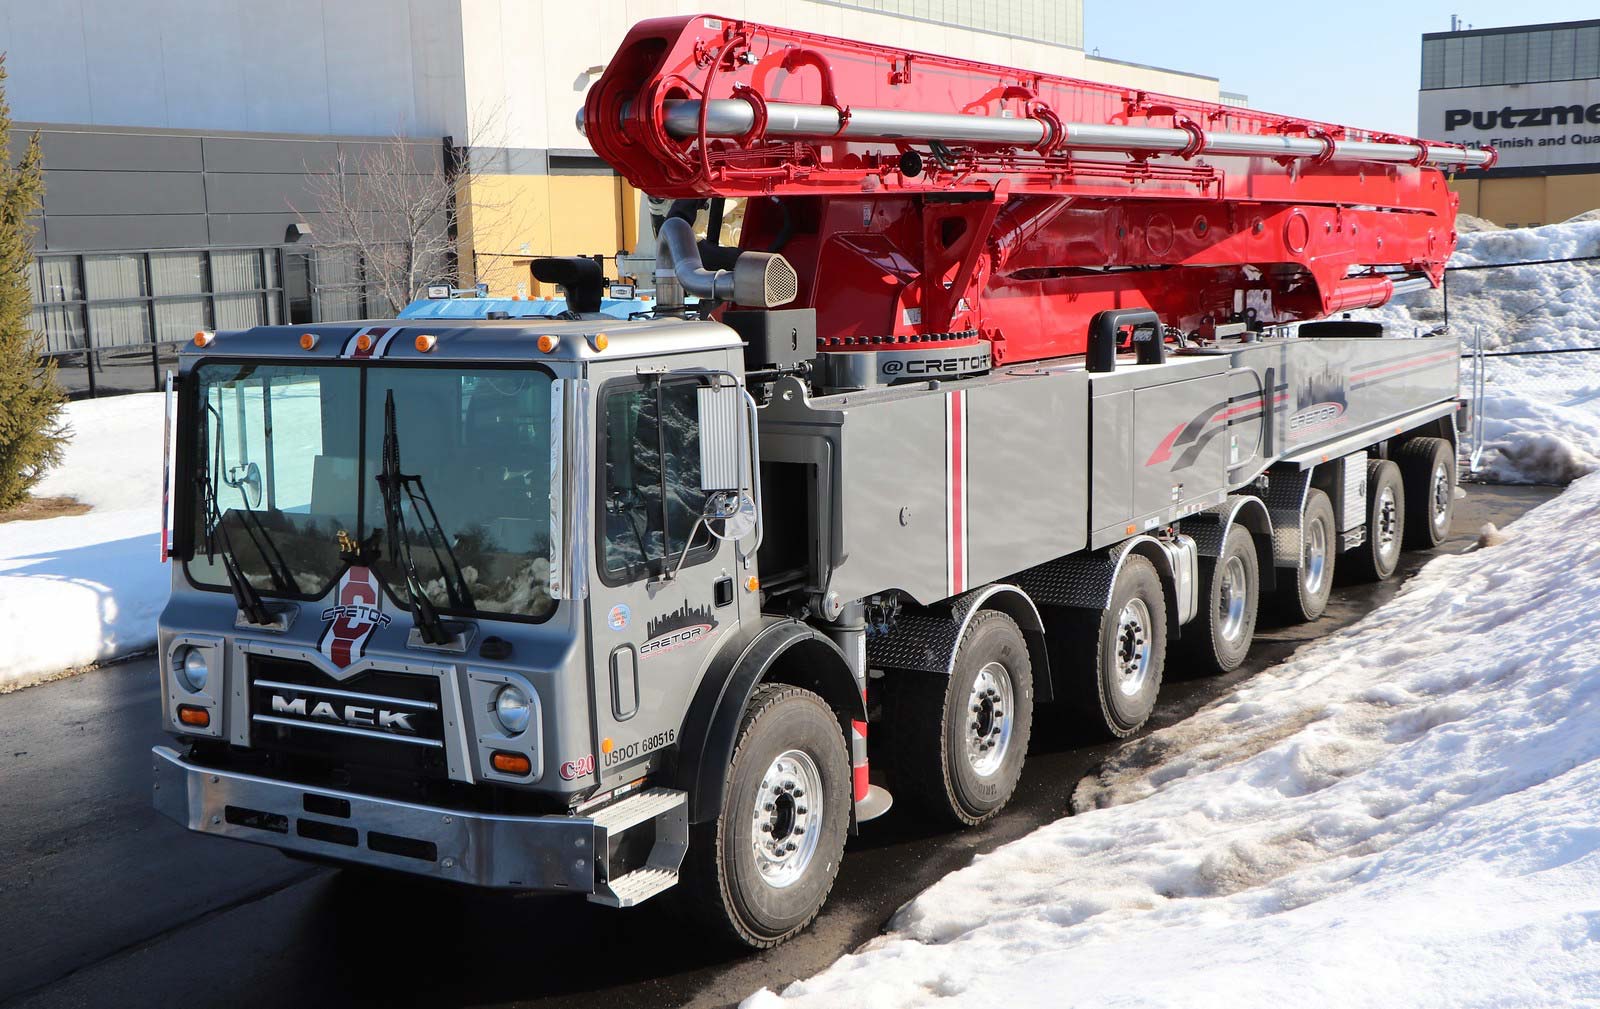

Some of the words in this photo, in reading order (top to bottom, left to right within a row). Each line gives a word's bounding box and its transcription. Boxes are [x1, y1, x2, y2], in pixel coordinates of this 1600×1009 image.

[1490, 137, 1533, 149] Finish
[1538, 135, 1566, 147] and
[321, 605, 393, 630] CRETOR
[640, 628, 701, 654] CRETOR
[272, 695, 416, 731] MACK
[604, 742, 640, 767] USDOT
[642, 729, 675, 752] 680516
